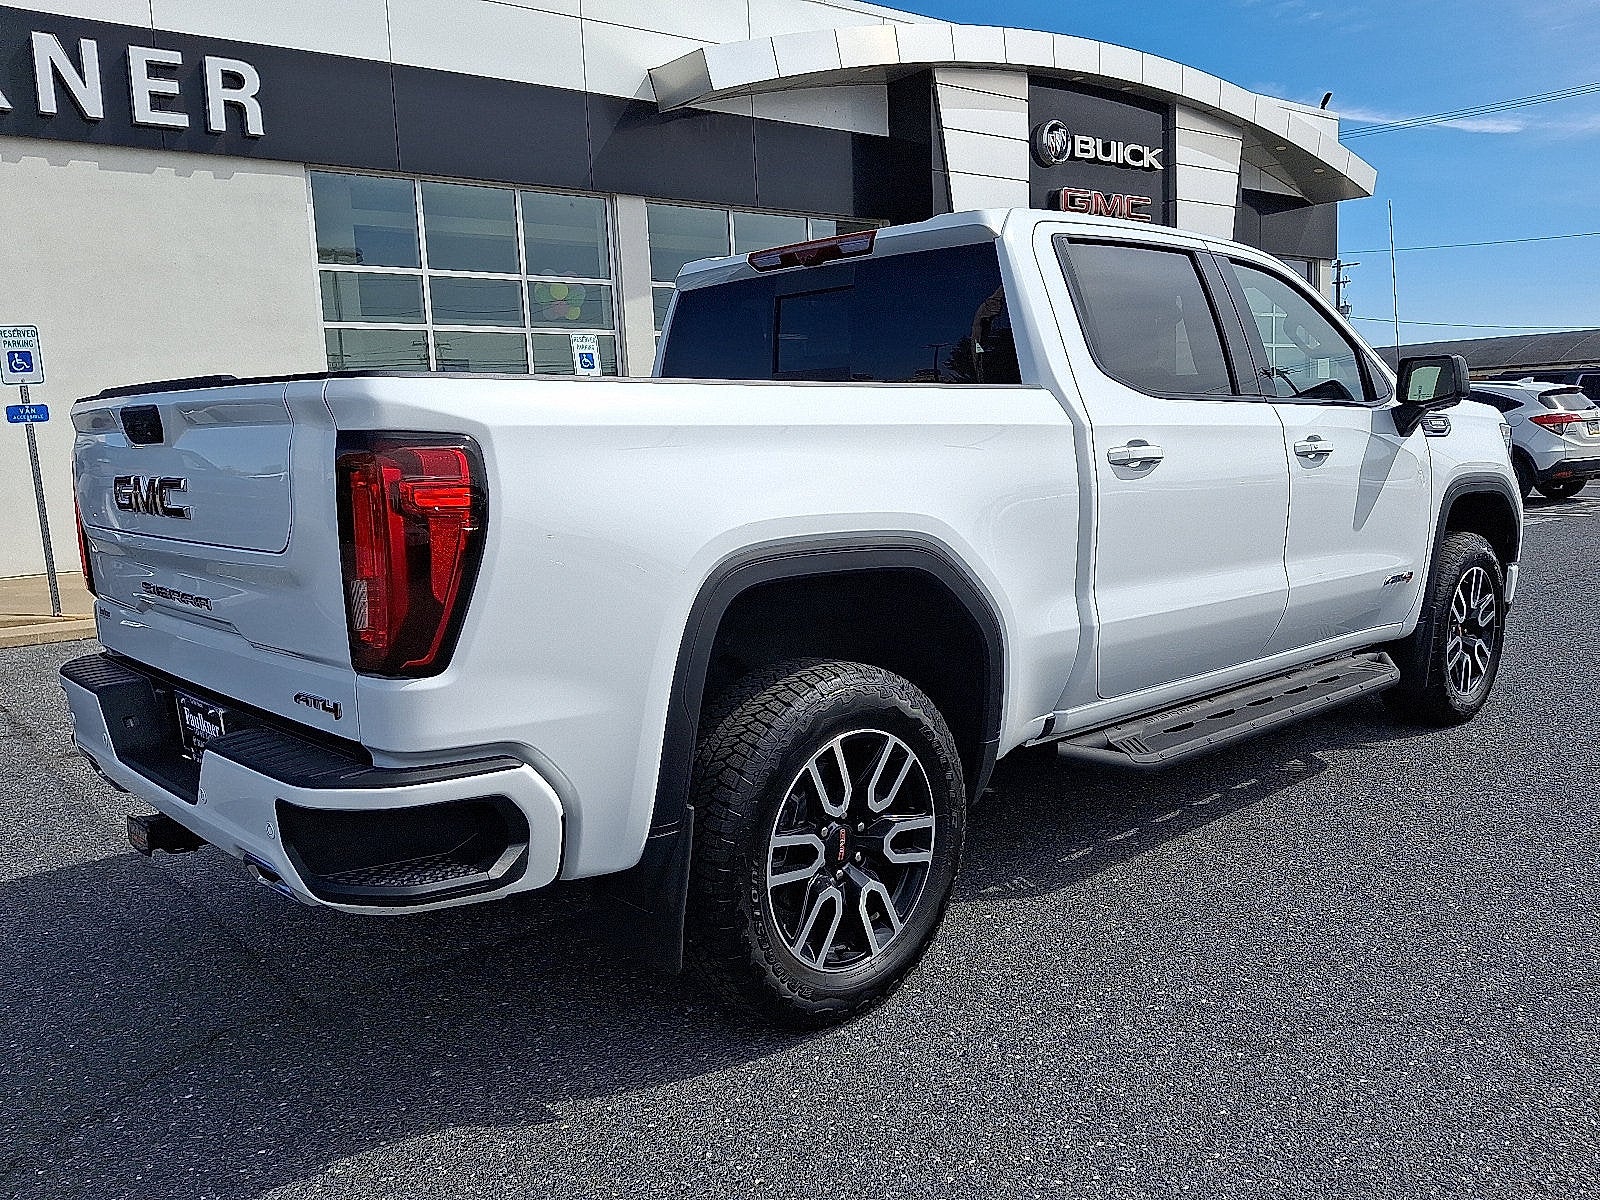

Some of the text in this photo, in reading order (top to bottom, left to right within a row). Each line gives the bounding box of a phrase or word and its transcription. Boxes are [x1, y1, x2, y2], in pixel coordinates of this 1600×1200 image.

[0, 30, 265, 137] NER
[1073, 134, 1165, 170] BUICK
[1062, 186, 1152, 222] GMC
[3, 340, 33, 348] PARKING
[113, 475, 191, 520] GMC
[141, 581, 213, 611] SIERRA
[293, 691, 343, 721] AT4
